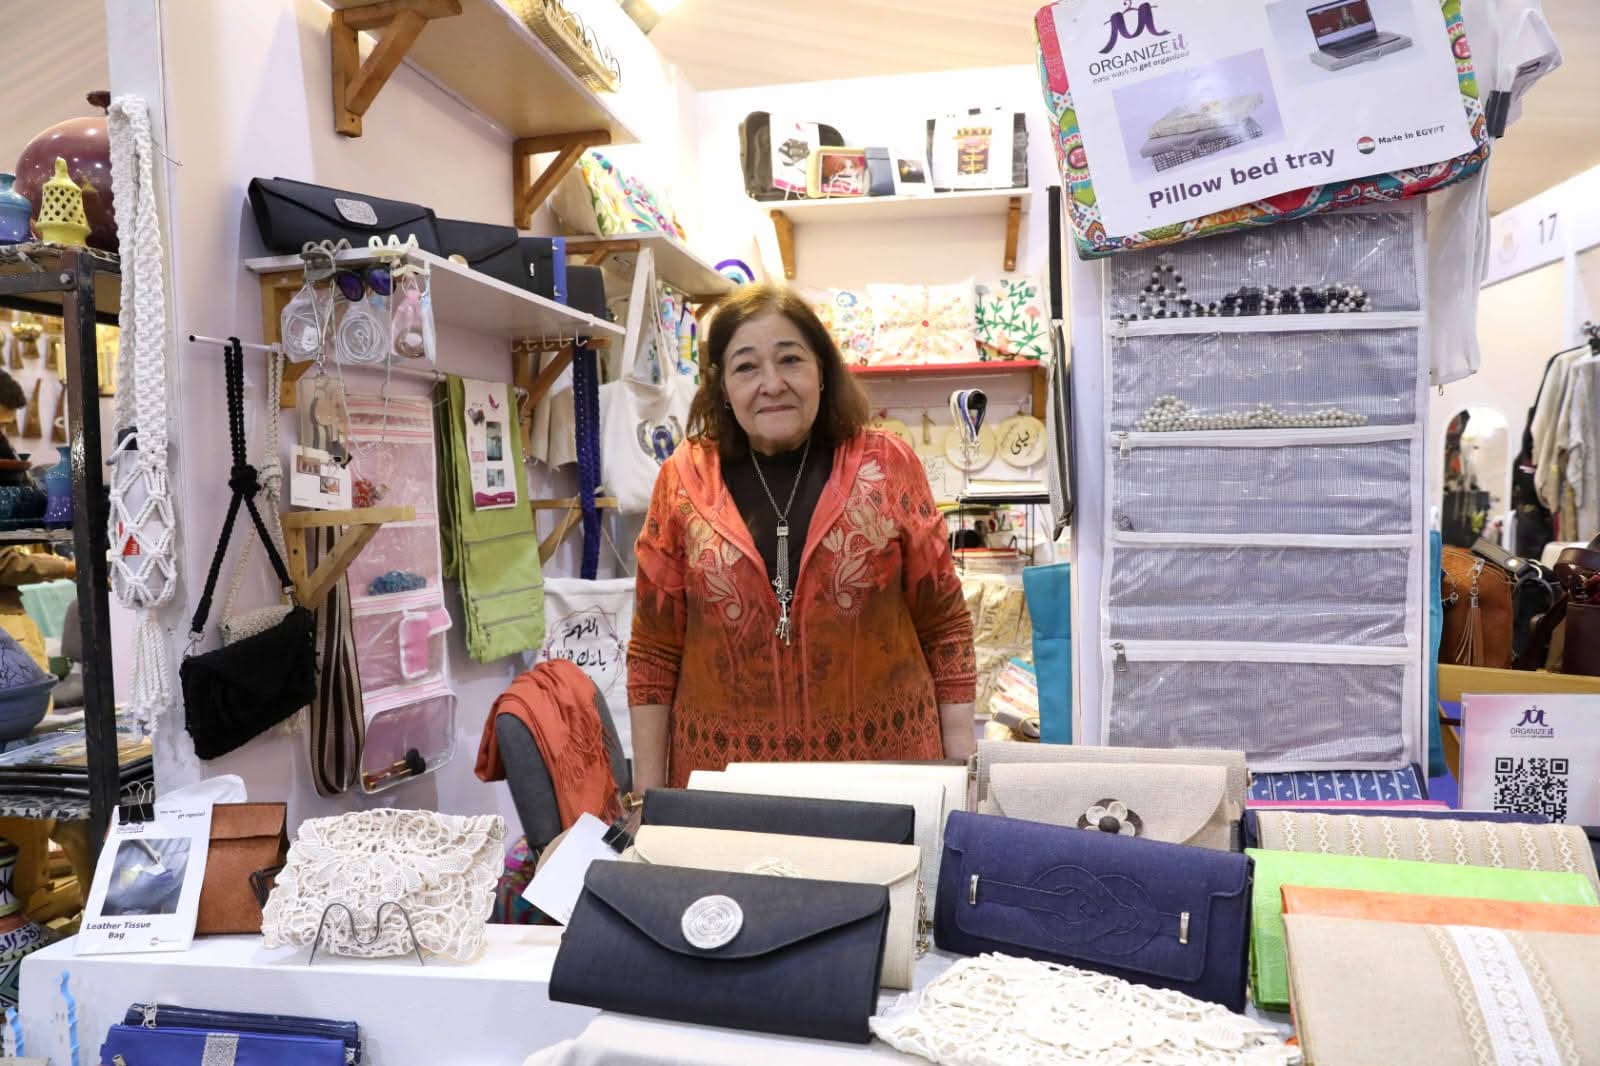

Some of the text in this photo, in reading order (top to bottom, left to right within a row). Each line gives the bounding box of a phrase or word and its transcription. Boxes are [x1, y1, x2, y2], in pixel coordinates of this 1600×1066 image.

[1088, 40, 1169, 76] ORGANIZE
[1139, 61, 1152, 72] get
[1378, 134, 1403, 145] Made
[1415, 125, 1445, 137] EGYPT
[1149, 149, 1335, 209] Pillow bed tray
[1538, 212, 1558, 246] 17
[86, 921, 152, 930] Leather Tissue
[107, 931, 126, 941] Bag
